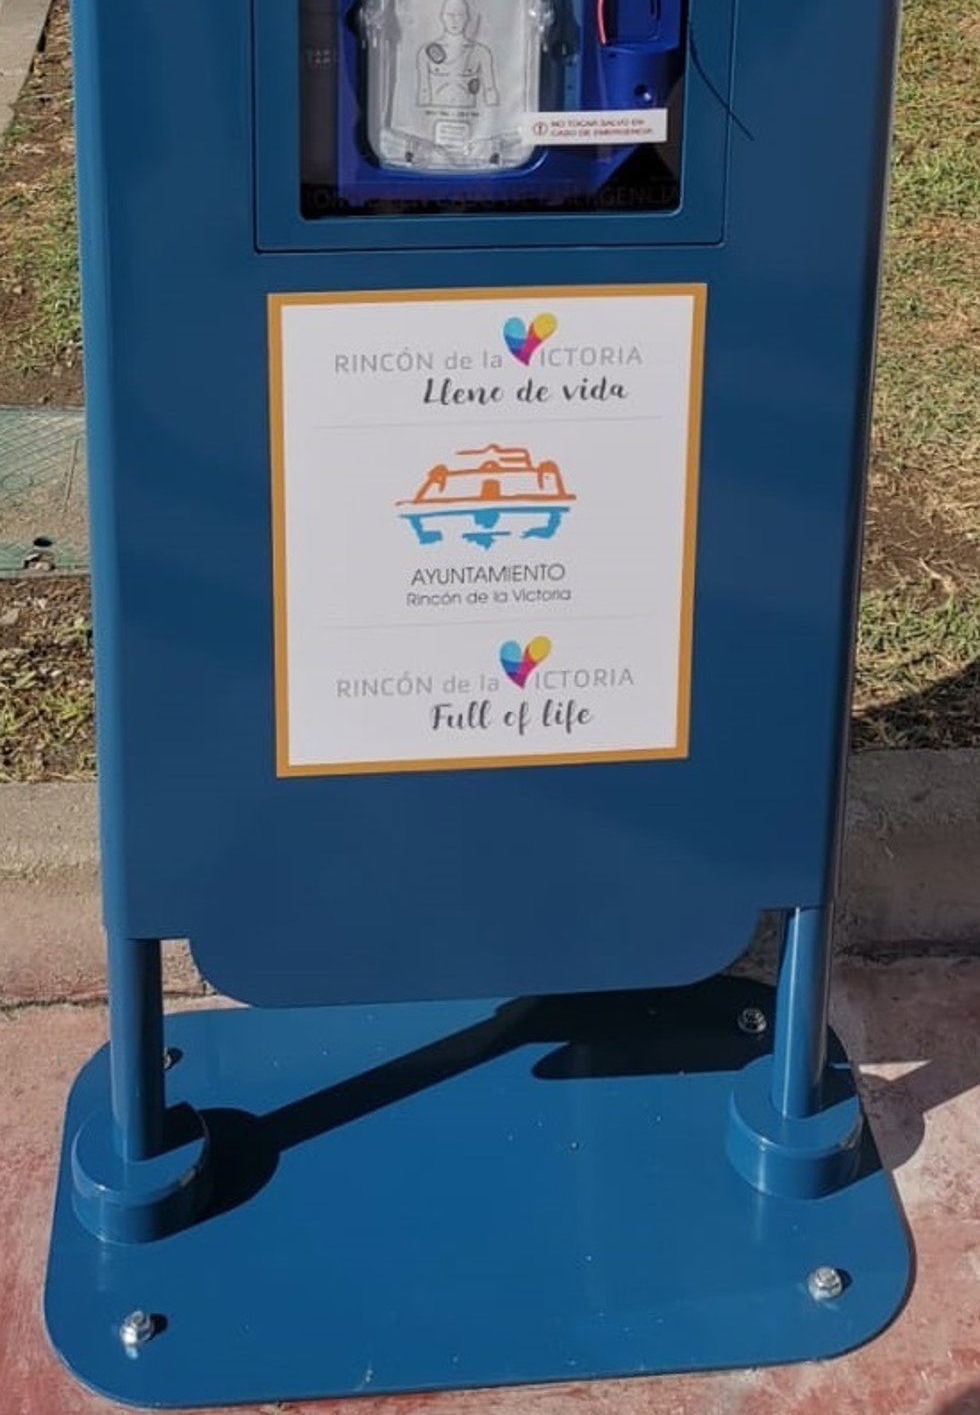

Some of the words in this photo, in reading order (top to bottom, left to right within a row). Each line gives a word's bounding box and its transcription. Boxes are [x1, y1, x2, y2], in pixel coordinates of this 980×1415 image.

[334, 347, 434, 374] RINCÓN
[444, 351, 474, 371] de
[483, 350, 503, 370] la
[516, 378, 550, 403] de
[563, 376, 629, 402] vida
[411, 563, 566, 587] AYUNTAMIENTO
[406, 590, 463, 607] Rincón
[466, 590, 488, 604] de
[492, 589, 508, 603] la
[513, 587, 571, 603] Victoria
[336, 671, 433, 698] RINCÓN
[443, 676, 471, 694] de
[480, 675, 499, 693] la
[432, 700, 492, 731] Full
[503, 700, 530, 735] of
[542, 699, 592, 734] life
